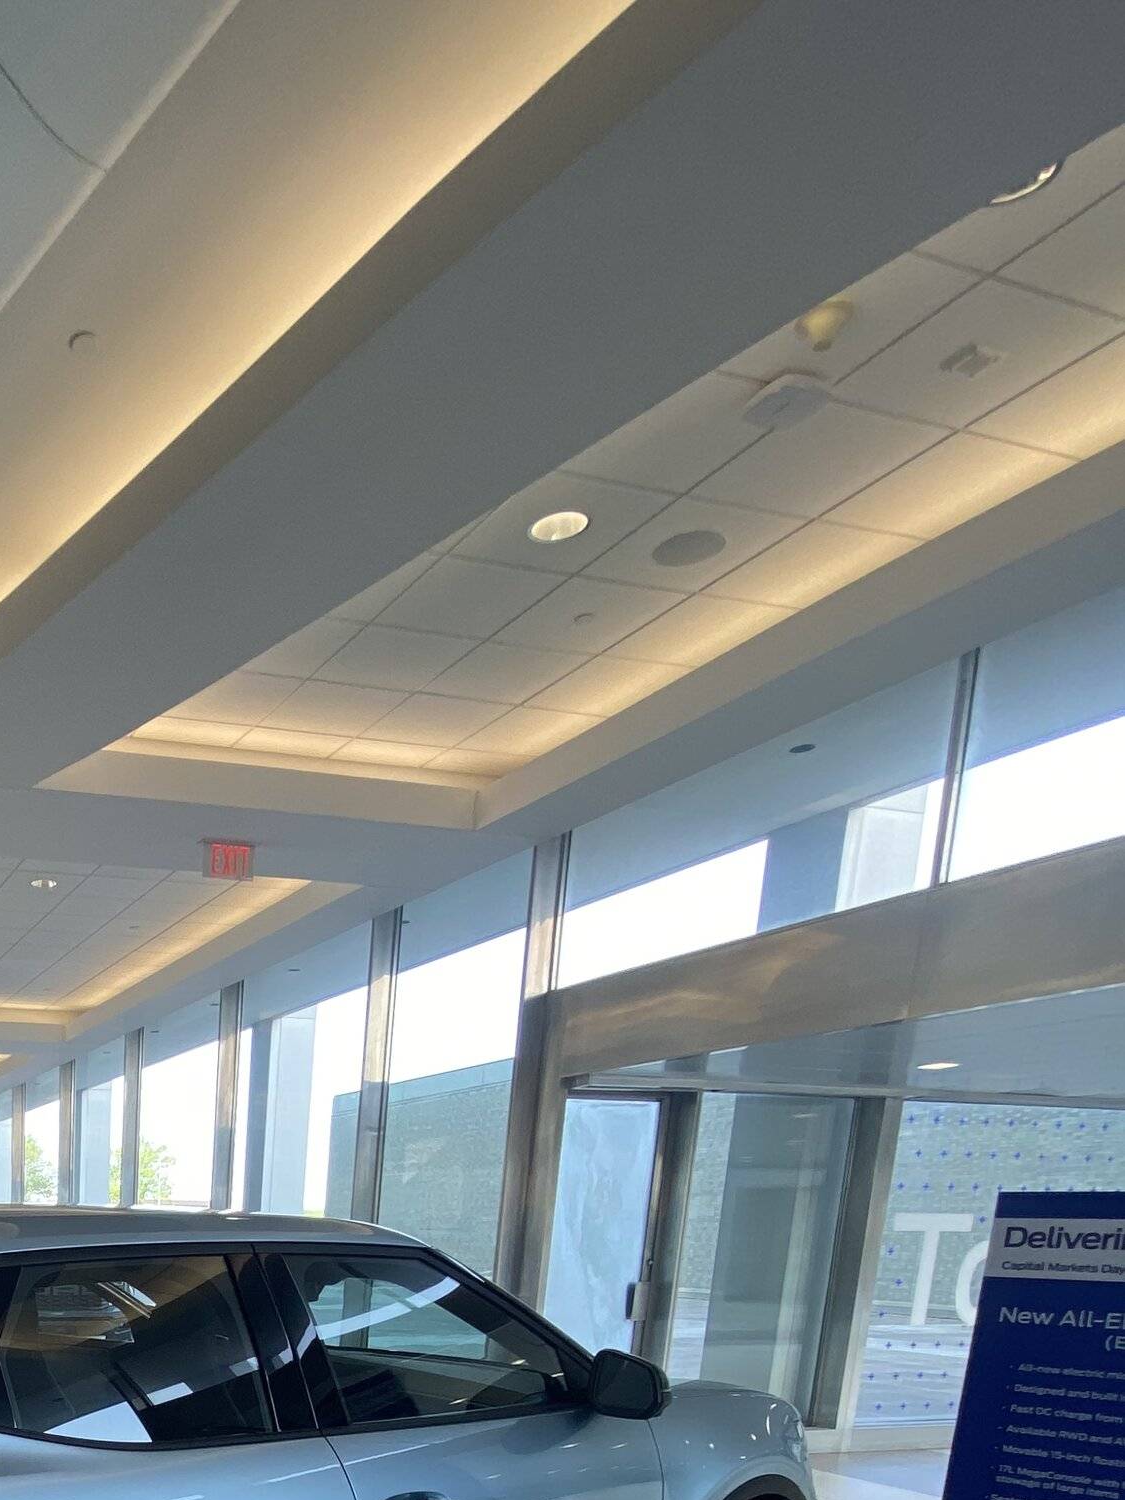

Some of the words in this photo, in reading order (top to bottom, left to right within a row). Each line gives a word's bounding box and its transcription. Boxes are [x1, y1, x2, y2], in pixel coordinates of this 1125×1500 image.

[1001, 1261, 1045, 1271] Capital
[1047, 1263, 1099, 1274] Markets
[998, 1306, 1055, 1326] New
[1014, 1384, 1066, 1396] Designed
